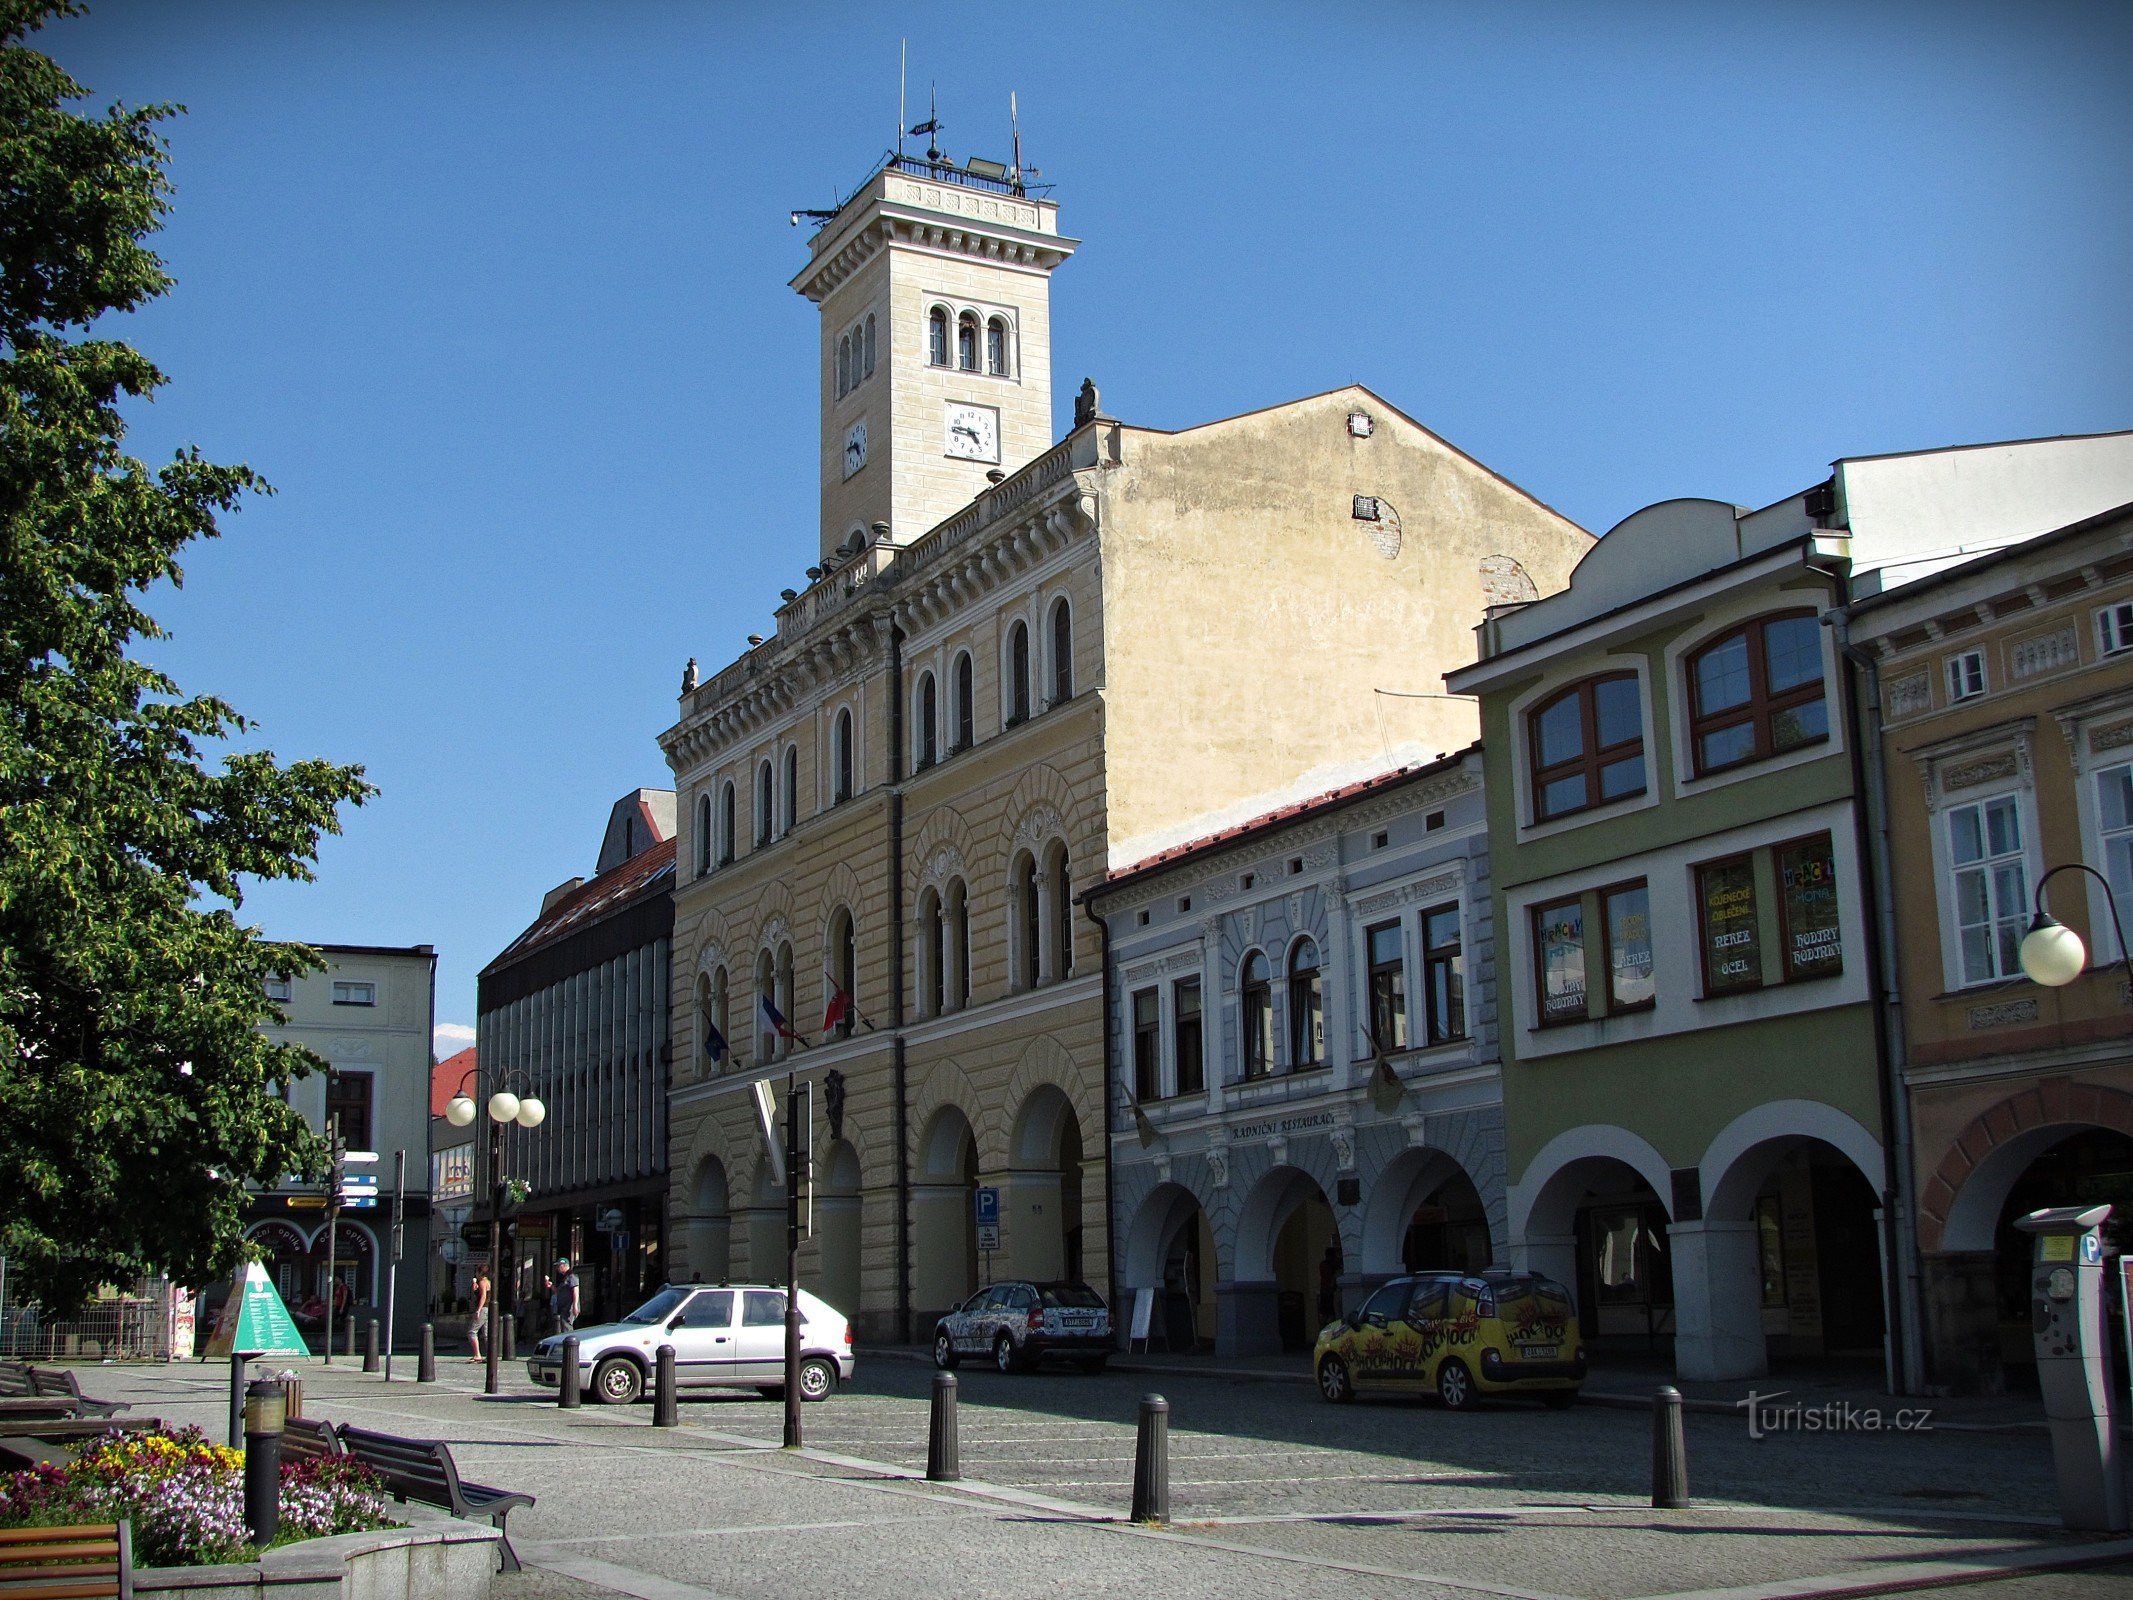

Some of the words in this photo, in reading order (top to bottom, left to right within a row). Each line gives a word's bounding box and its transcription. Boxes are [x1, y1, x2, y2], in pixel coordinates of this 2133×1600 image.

[1715, 930, 1751, 948] NEREZ
[1721, 959, 1748, 975] OCEL
[1233, 1121, 1277, 1139] RADNIČNÍ
[980, 1193, 994, 1214] P
[278, 1228, 301, 1251] optika
[345, 1229, 368, 1252] optika
[2084, 1236, 2099, 1261] P
